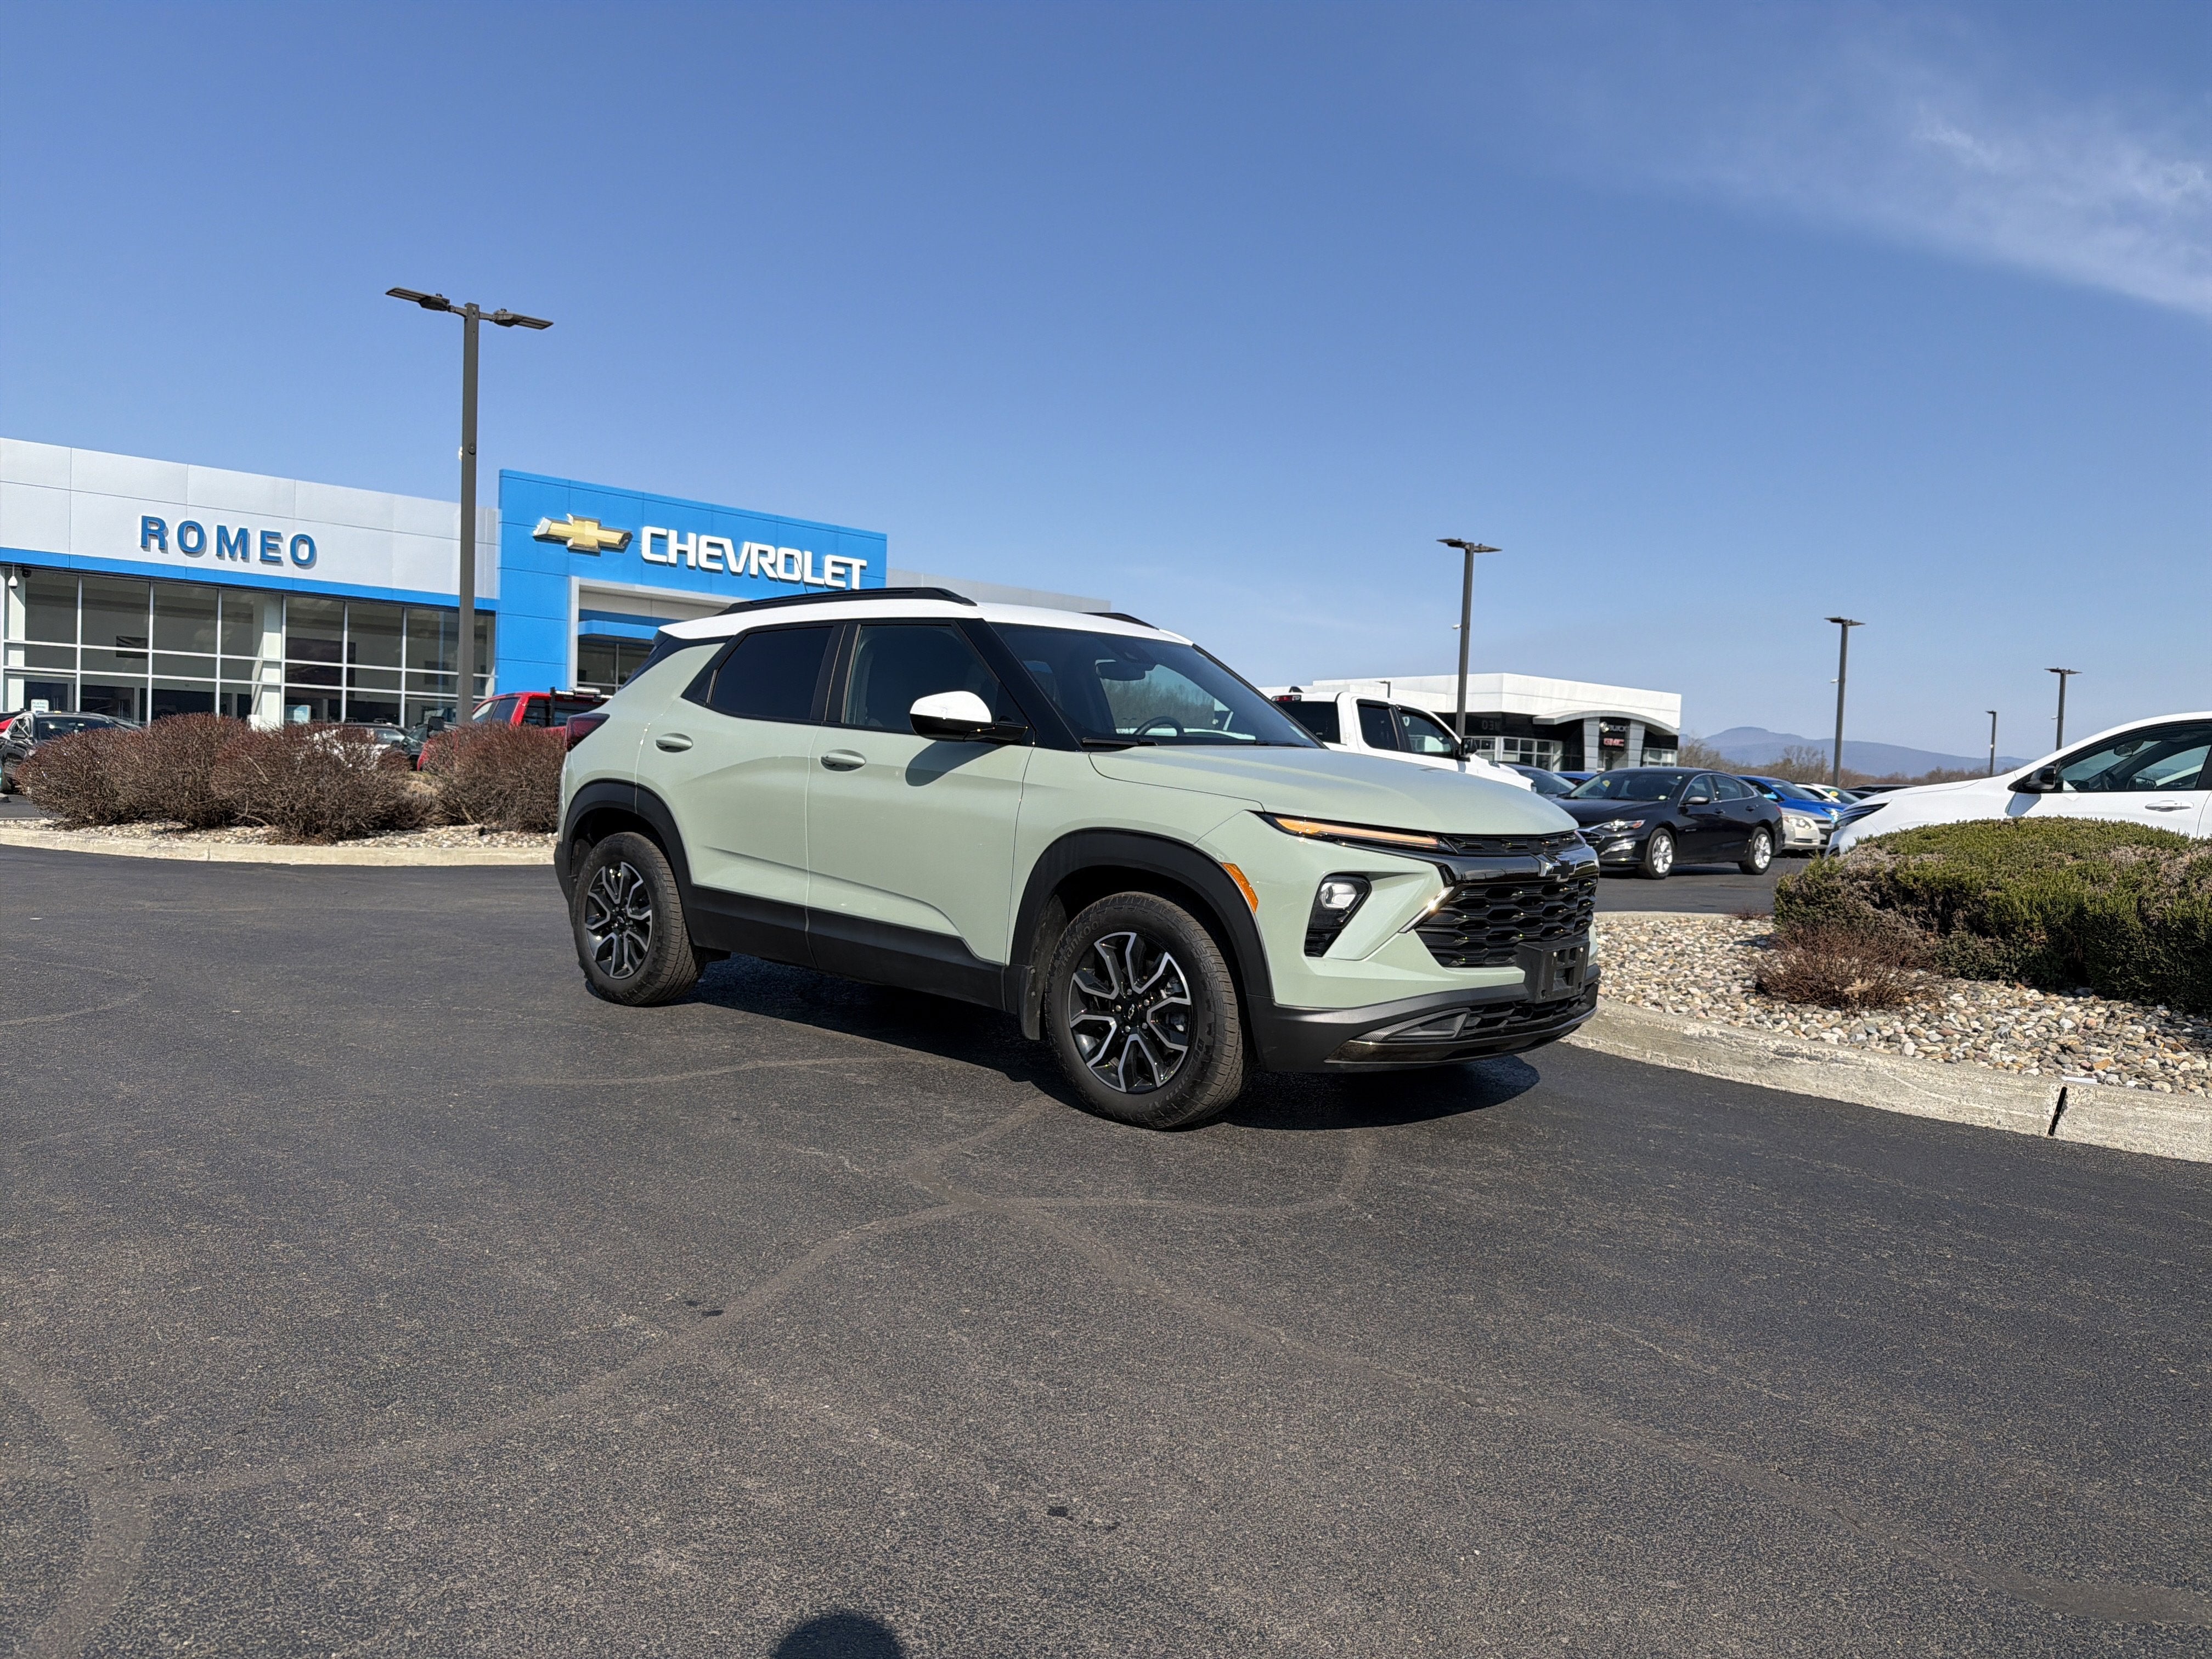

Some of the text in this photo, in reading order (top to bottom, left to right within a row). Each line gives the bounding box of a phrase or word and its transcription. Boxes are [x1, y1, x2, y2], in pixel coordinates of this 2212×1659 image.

[140, 515, 317, 565] ROMEO
[641, 526, 867, 589] CHEVROLET
[1604, 738, 1624, 747] GMC
